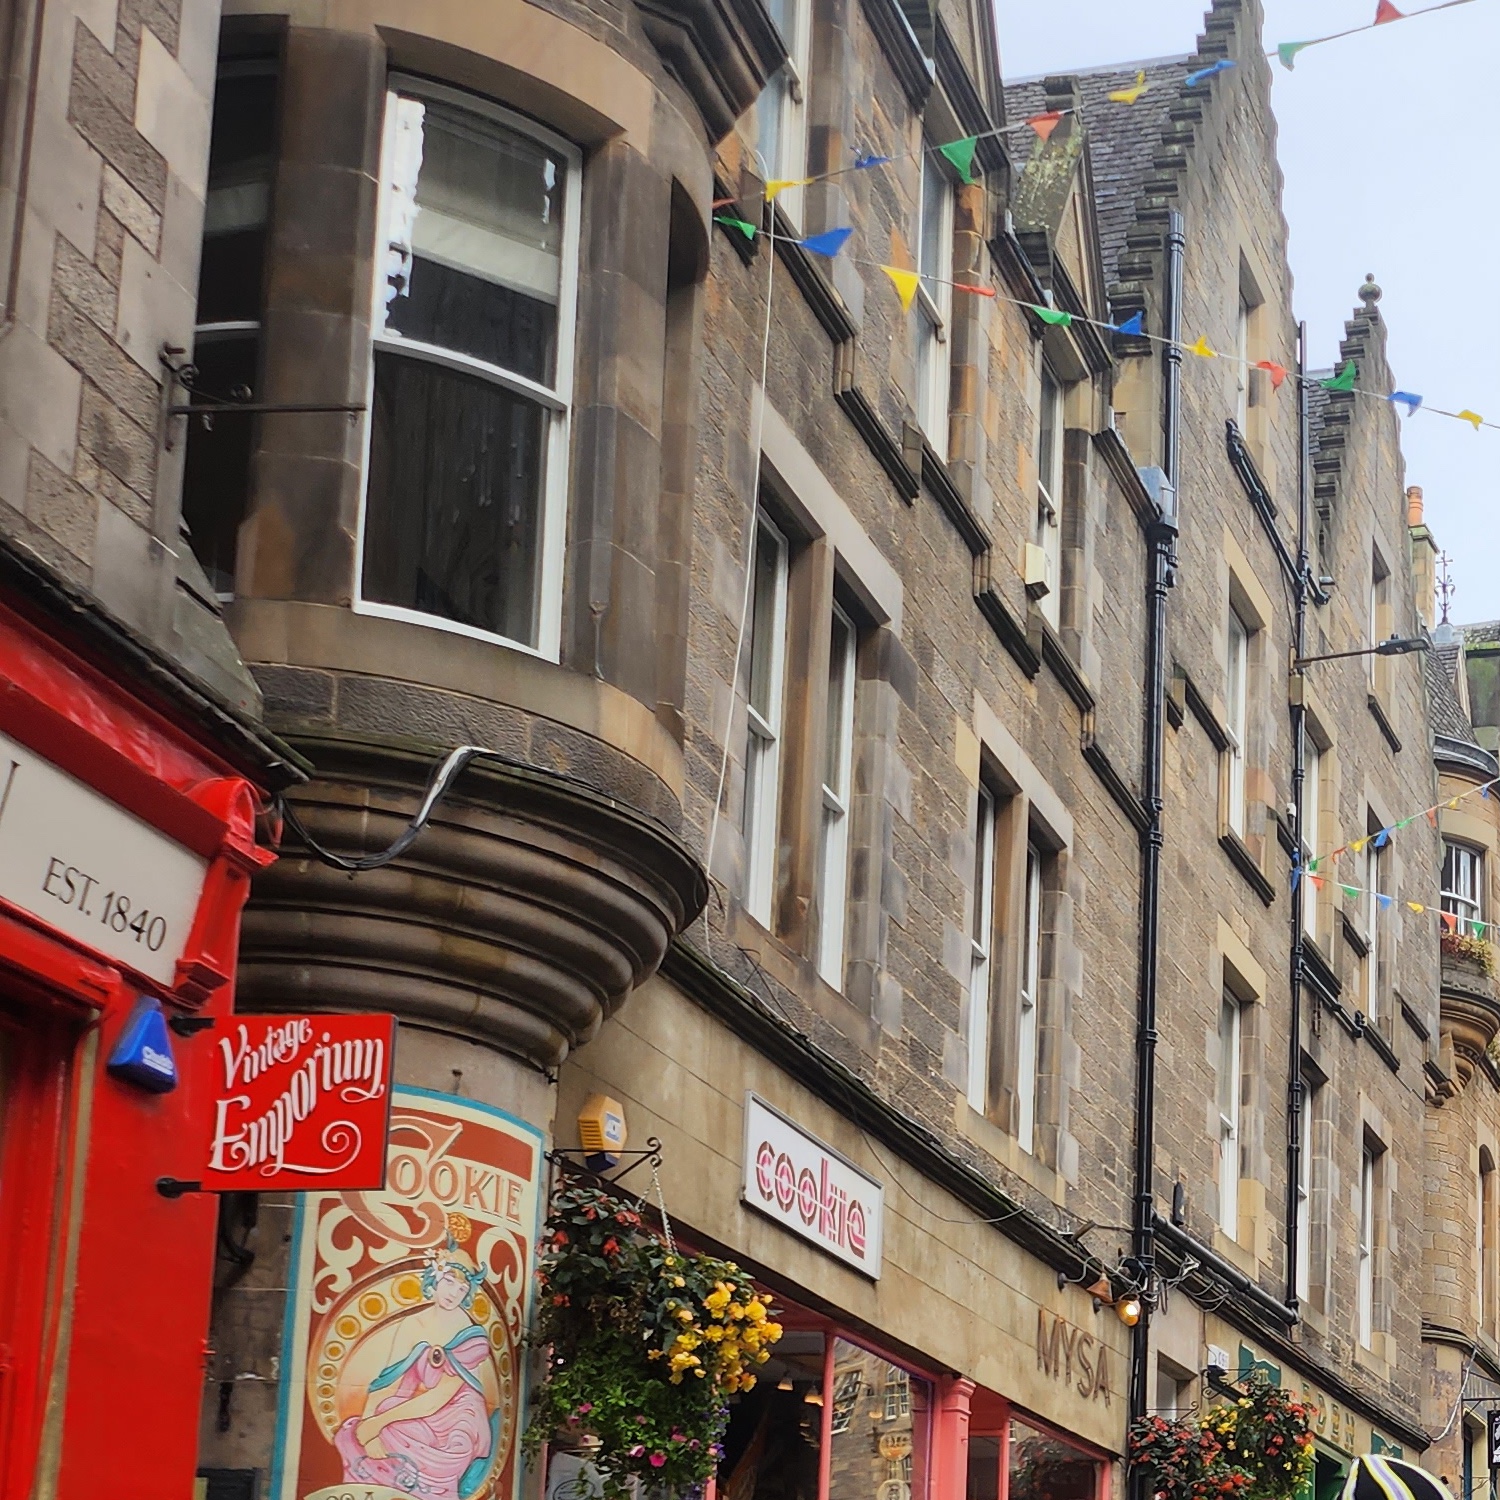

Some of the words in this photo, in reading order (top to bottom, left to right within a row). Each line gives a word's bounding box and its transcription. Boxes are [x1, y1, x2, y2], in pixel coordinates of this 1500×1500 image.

[42, 856, 100, 916] EST.
[100, 891, 167, 951] 1840
[219, 1017, 313, 1089] Vintage
[207, 1031, 385, 1177] Emporium
[756, 1140, 866, 1260] cookie
[1037, 1307, 1112, 1408] MYSA
